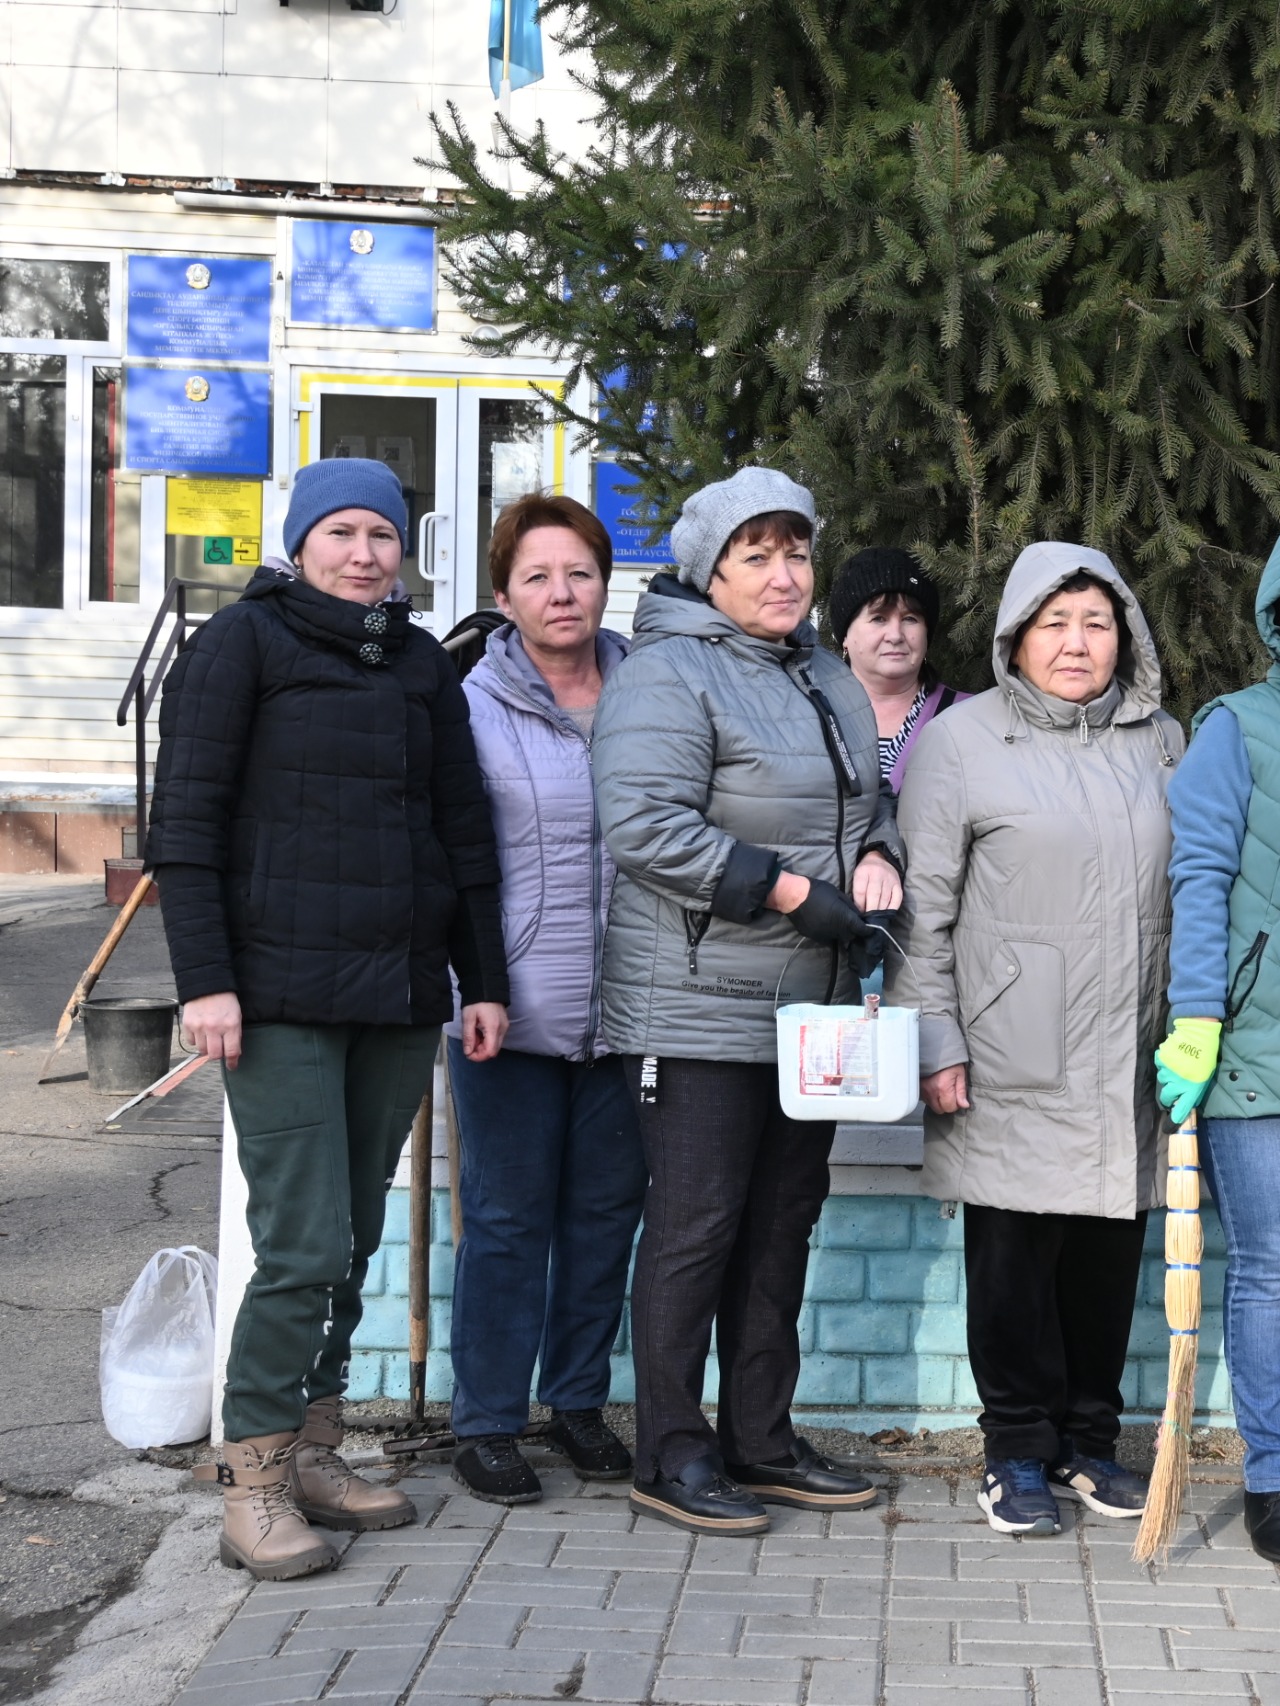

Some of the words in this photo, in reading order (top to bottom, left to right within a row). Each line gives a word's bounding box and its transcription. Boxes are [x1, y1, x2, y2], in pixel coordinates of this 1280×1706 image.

[681, 980, 699, 989] Give
[699, 984, 715, 992] you
[716, 985, 729, 993] the
[730, 987, 755, 997] beauty
[716, 976, 763, 987] SYMONDER
